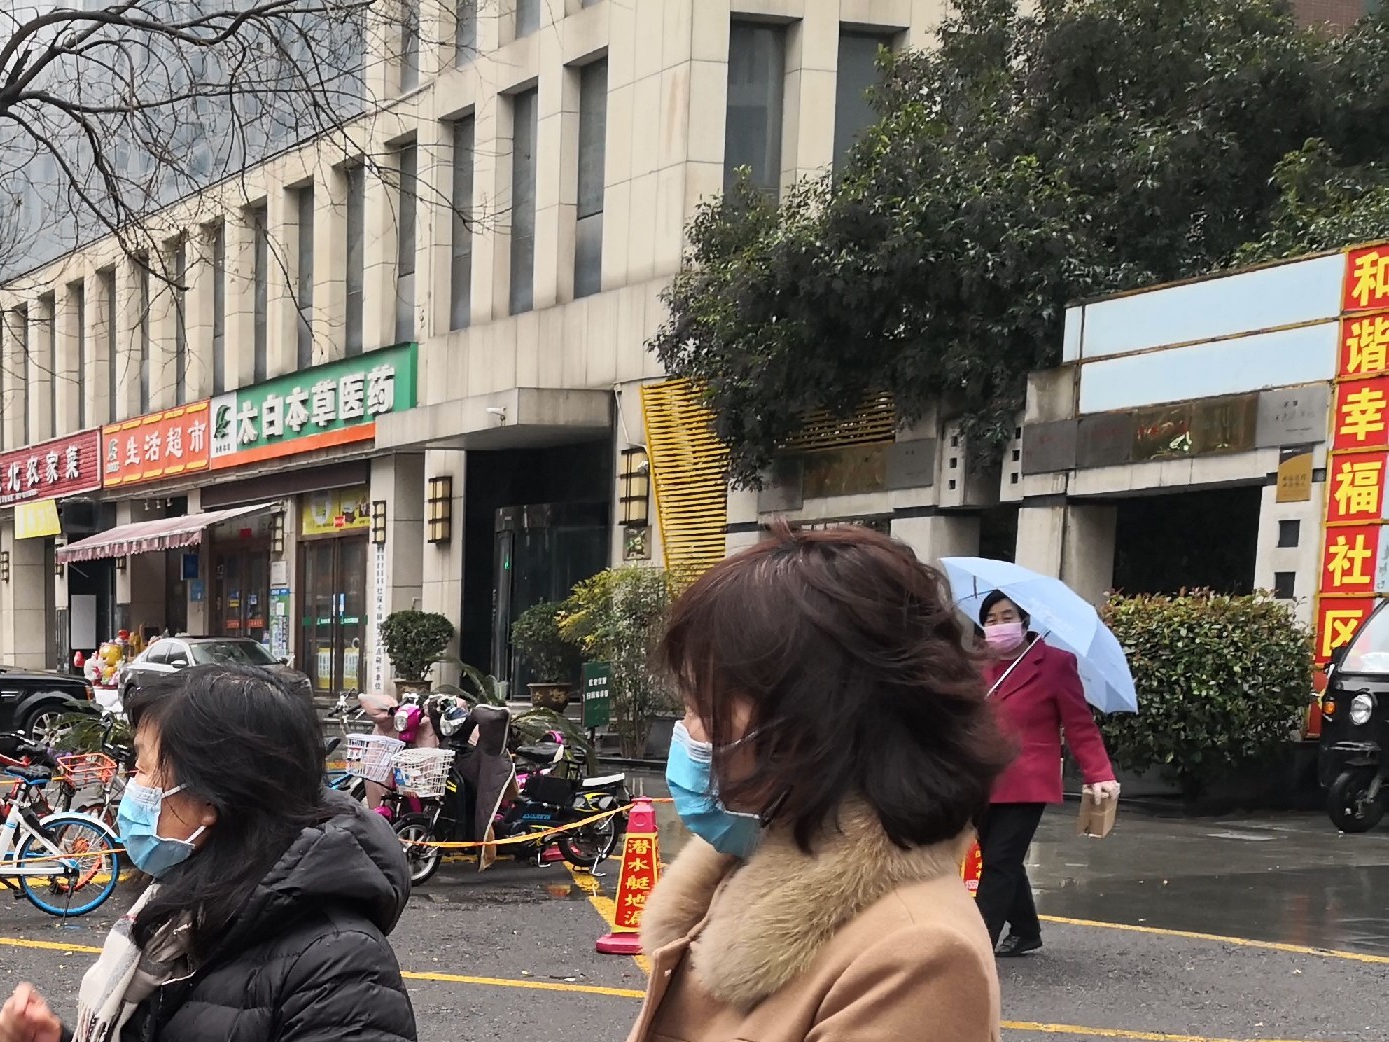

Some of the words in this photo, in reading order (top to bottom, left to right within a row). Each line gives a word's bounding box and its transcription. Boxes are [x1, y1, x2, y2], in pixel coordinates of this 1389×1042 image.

[124, 420, 209, 466] 生活超市
[236, 364, 396, 445] 太白本草医药
[1321, 251, 1389, 658] 和谐幸福社区
